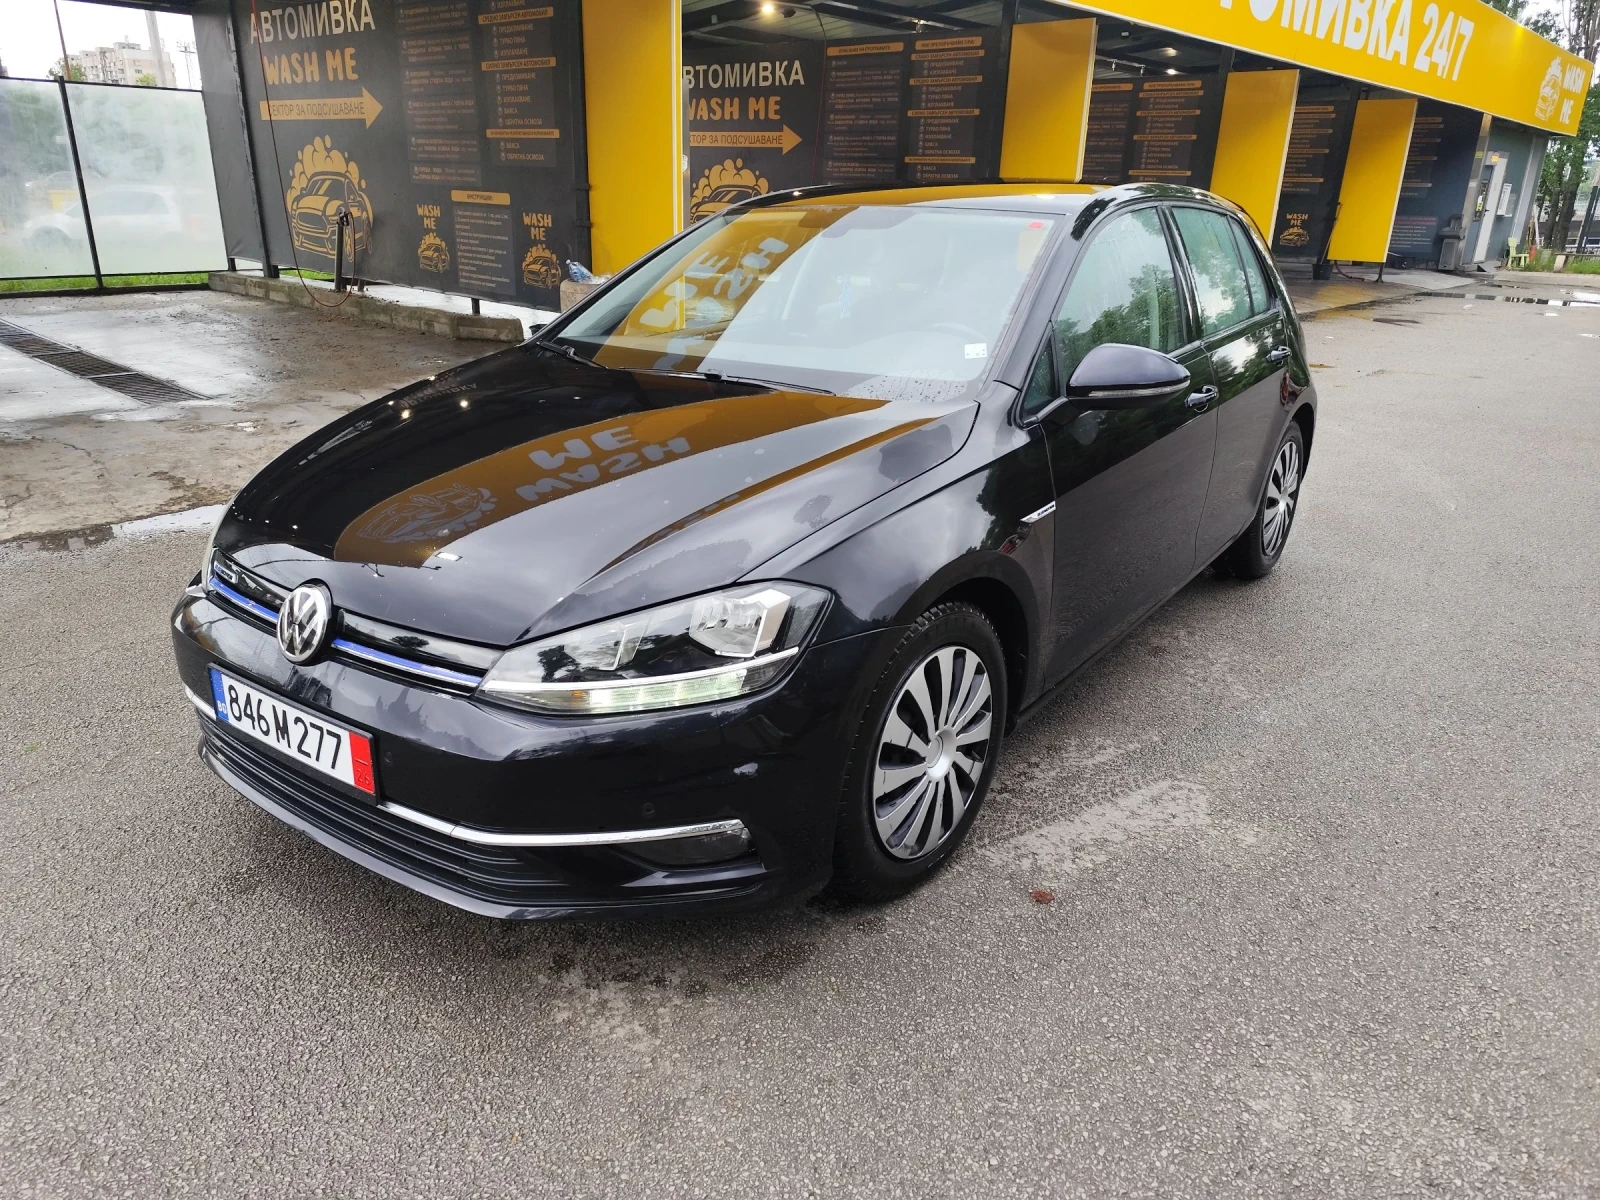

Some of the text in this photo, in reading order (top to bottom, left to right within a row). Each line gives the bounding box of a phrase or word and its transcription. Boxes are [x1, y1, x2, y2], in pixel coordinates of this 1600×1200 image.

[250, 0, 376, 44] АВТОМИВКА
[1220, 0, 1475, 81] ИВКА 24/7
[263, 47, 359, 85] WASH ME
[1563, 63, 1586, 94] WASH
[295, 103, 306, 116] ЗА
[307, 101, 366, 117] ПОДСУШАВАНЕ
[748, 96, 781, 120] ME
[1559, 98, 1574, 124] ME
[709, 135, 719, 144] ЗА
[721, 134, 783, 145] ПОДСУШАВАНЕ
[417, 204, 441, 217] WASH
[423, 217, 437, 229] ME
[523, 212, 552, 227] WASH
[530, 227, 546, 240] ME
[217, 700, 227, 714] BG
